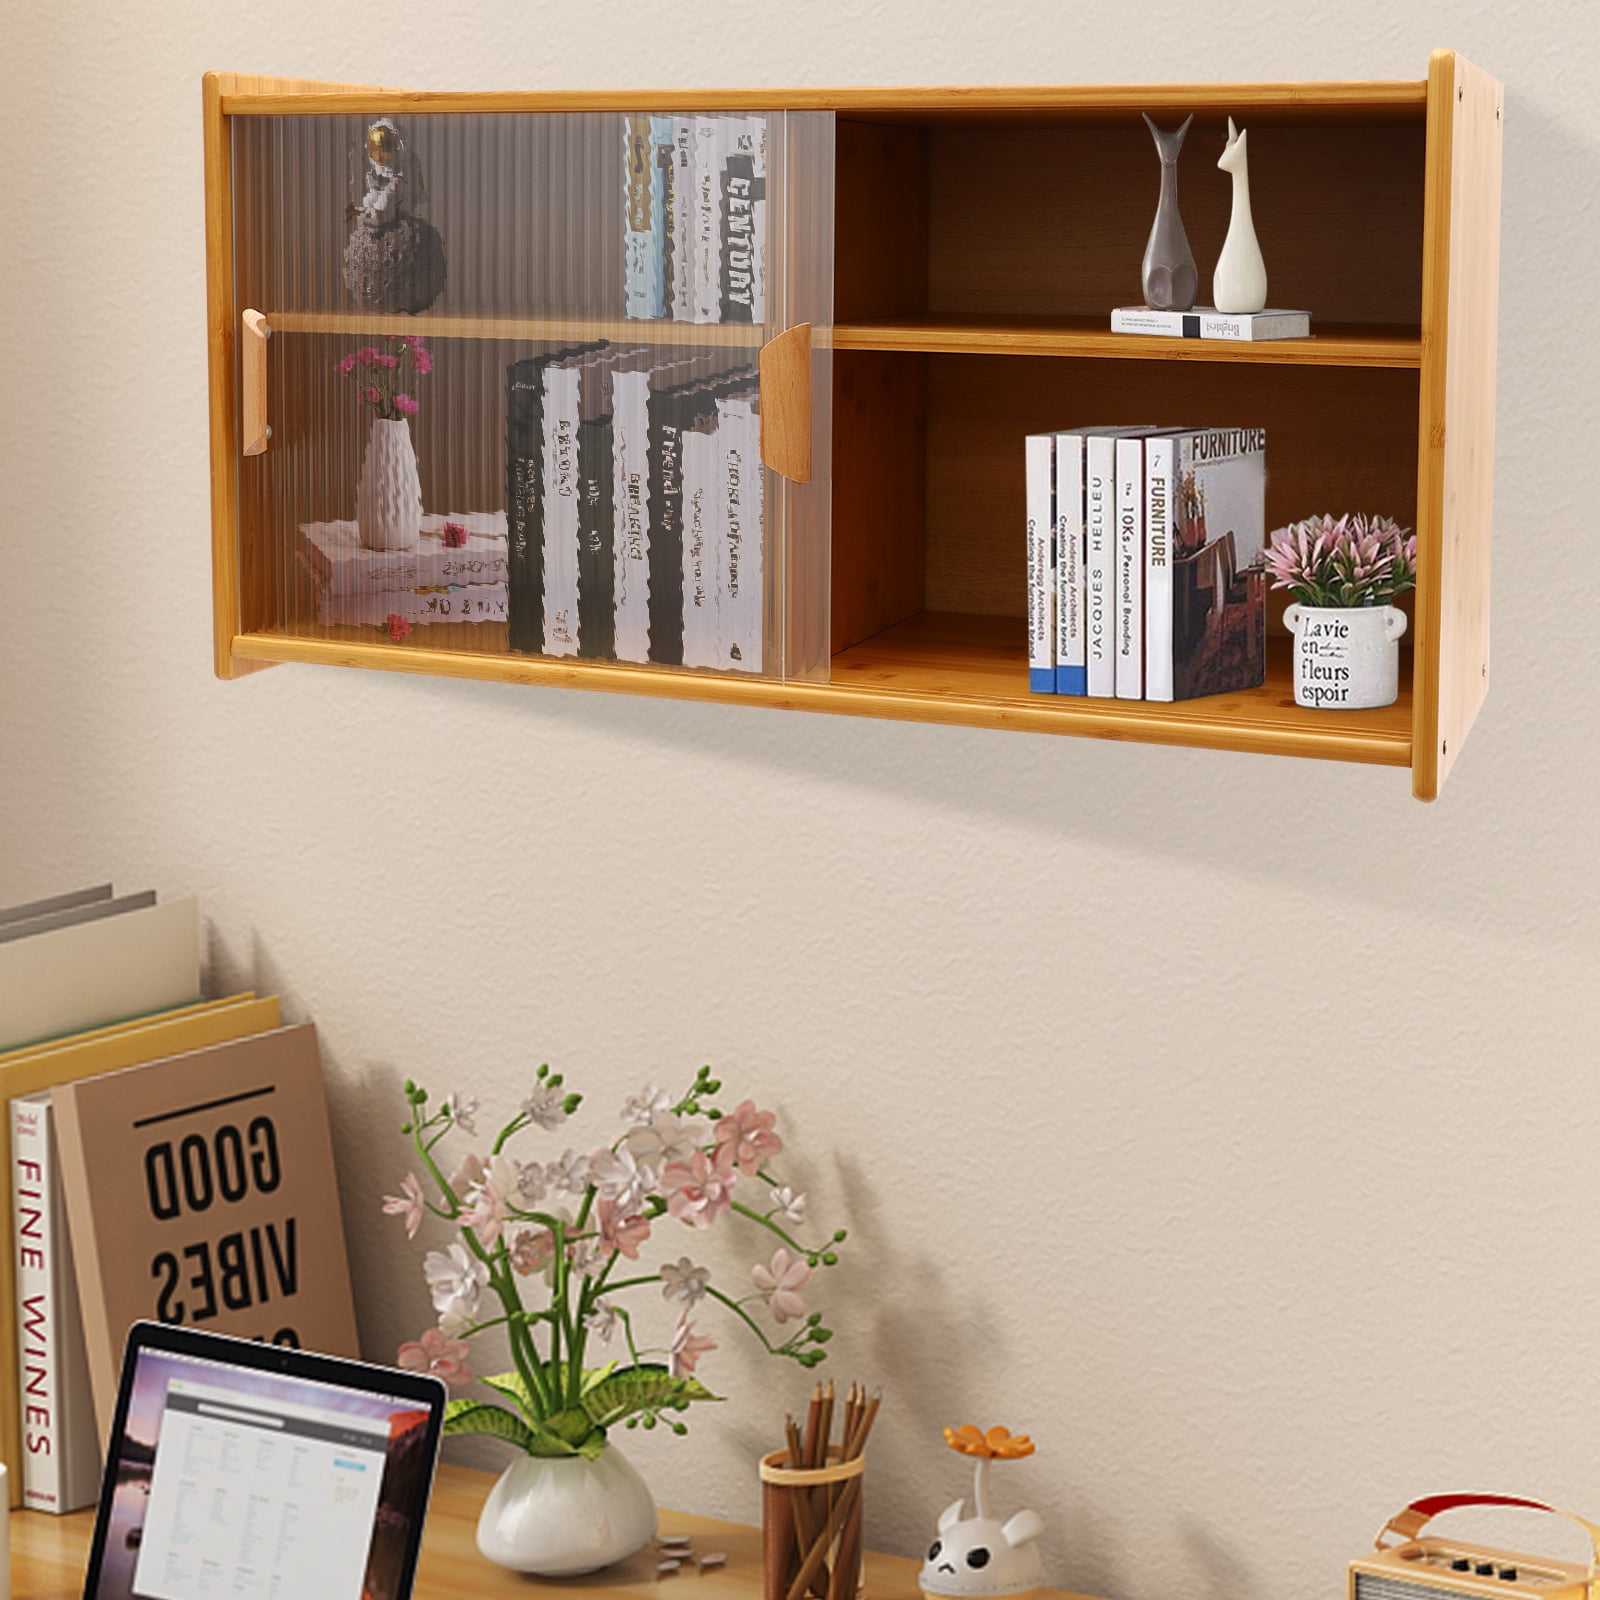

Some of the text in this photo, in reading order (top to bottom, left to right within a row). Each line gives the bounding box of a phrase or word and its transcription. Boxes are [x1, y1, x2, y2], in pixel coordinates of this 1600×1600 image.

[727, 177, 751, 304] CENTURY
[1192, 429, 1265, 461] FURNITURE
[1121, 507, 1134, 543] 10Ks
[1151, 477, 1166, 567] FURNITURE
[1036, 537, 1046, 641] Anderegg Architects
[1058, 515, 1068, 657] Creating the furniture brand
[1068, 534, 1078, 639] Anderegg Architects
[1092, 477, 1103, 660] JACQUES HELLEU
[1122, 554, 1132, 603] Personal
[1121, 608, 1132, 656] Branding
[1301, 641, 1319, 654] en
[1301, 658, 1350, 680] fleurs
[1301, 683, 1350, 706] espoir
[17, 1159, 44, 1270] FINE
[22, 1295, 51, 1456] WINES
